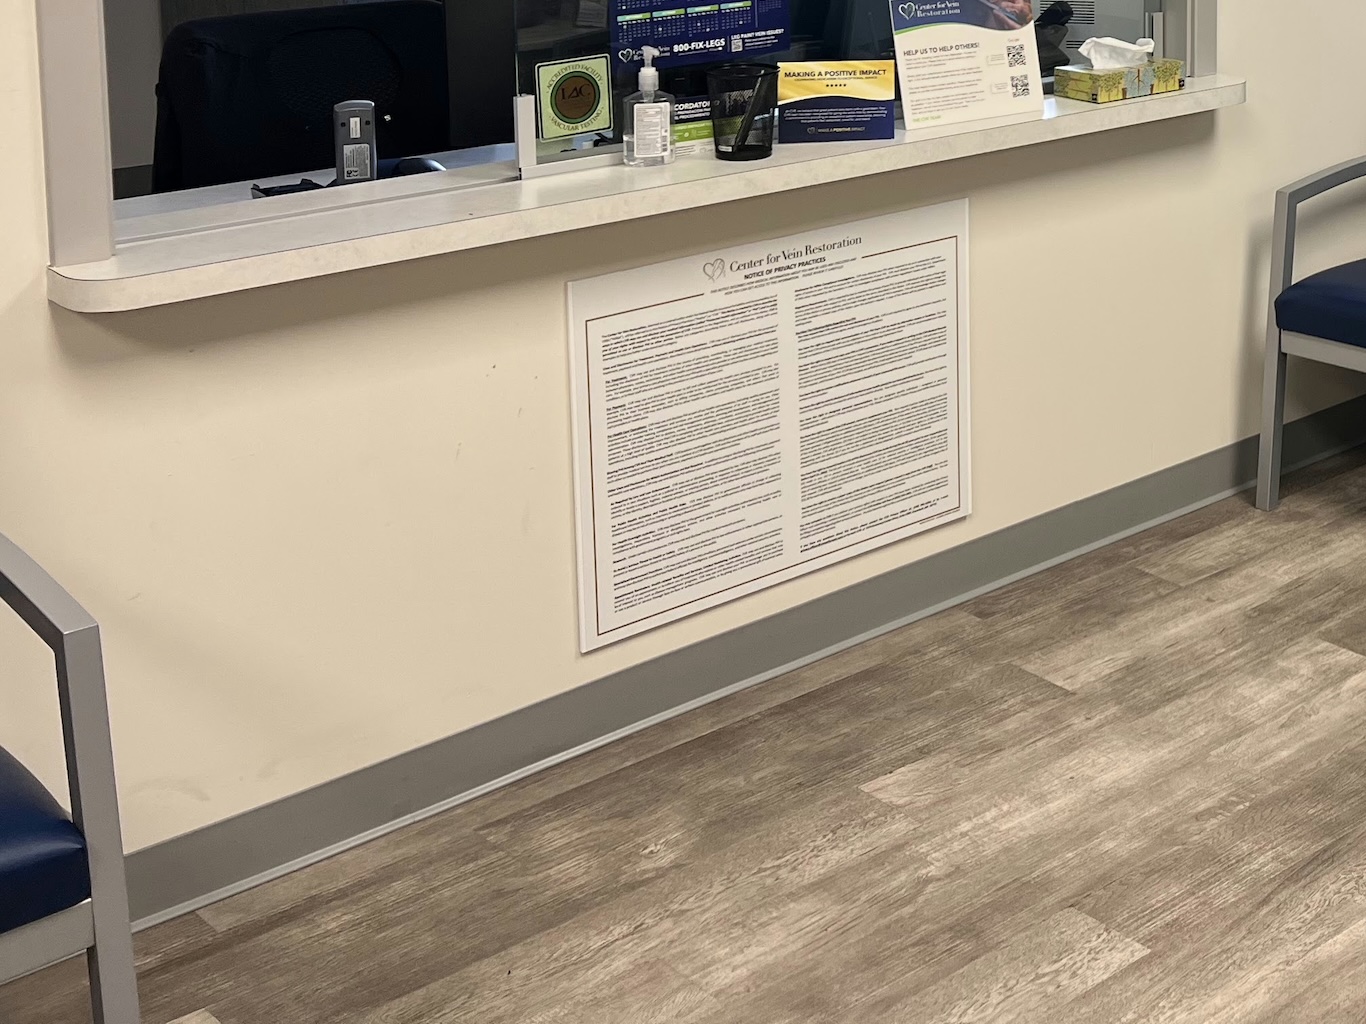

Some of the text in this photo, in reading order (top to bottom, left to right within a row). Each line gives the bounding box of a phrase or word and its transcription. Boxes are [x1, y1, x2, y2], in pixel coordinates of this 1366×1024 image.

[917, 9, 961, 17] Restoration
[673, 38, 726, 53] 800-FIX-LEGS
[955, 42, 979, 51] OTHERS!
[546, 64, 603, 90] ACCREDITED FACILITY
[551, 109, 603, 131] VASCULAR TESTING
[729, 236, 862, 272] Center for Vein Restoration
[744, 270, 764, 280] NOTICE
[774, 263, 797, 273] PRIVACY
[798, 256, 826, 268] PRACTICES
